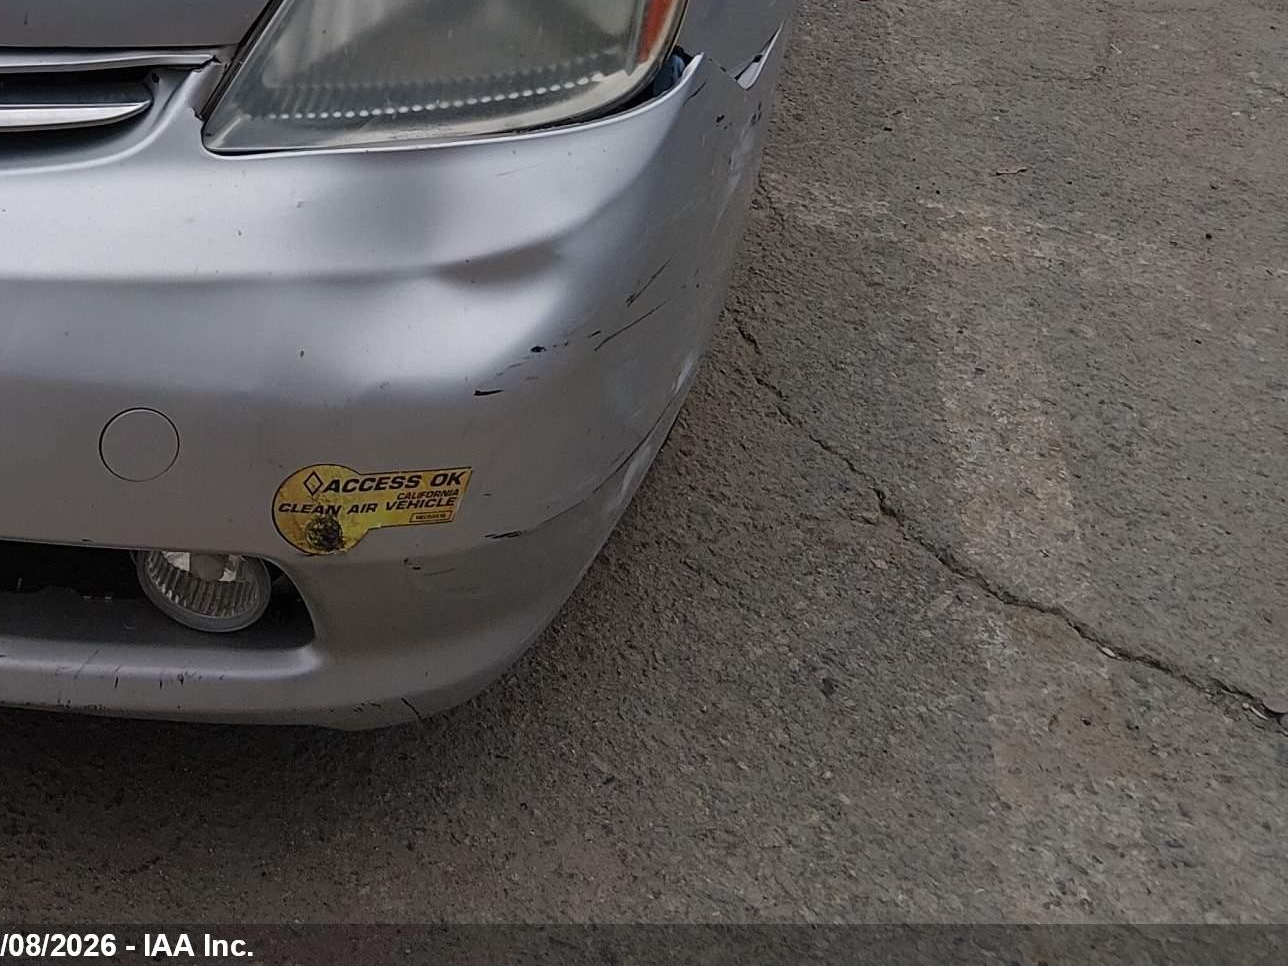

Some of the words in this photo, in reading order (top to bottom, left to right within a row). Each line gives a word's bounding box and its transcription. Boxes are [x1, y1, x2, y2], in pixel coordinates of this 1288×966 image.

[323, 474, 421, 494] ACCESS
[430, 470, 465, 486] OK
[396, 488, 460, 501] CALIFORNIA
[278, 502, 342, 516] CLEAN
[346, 502, 378, 515] AIR
[385, 497, 457, 511] VEHICLE
